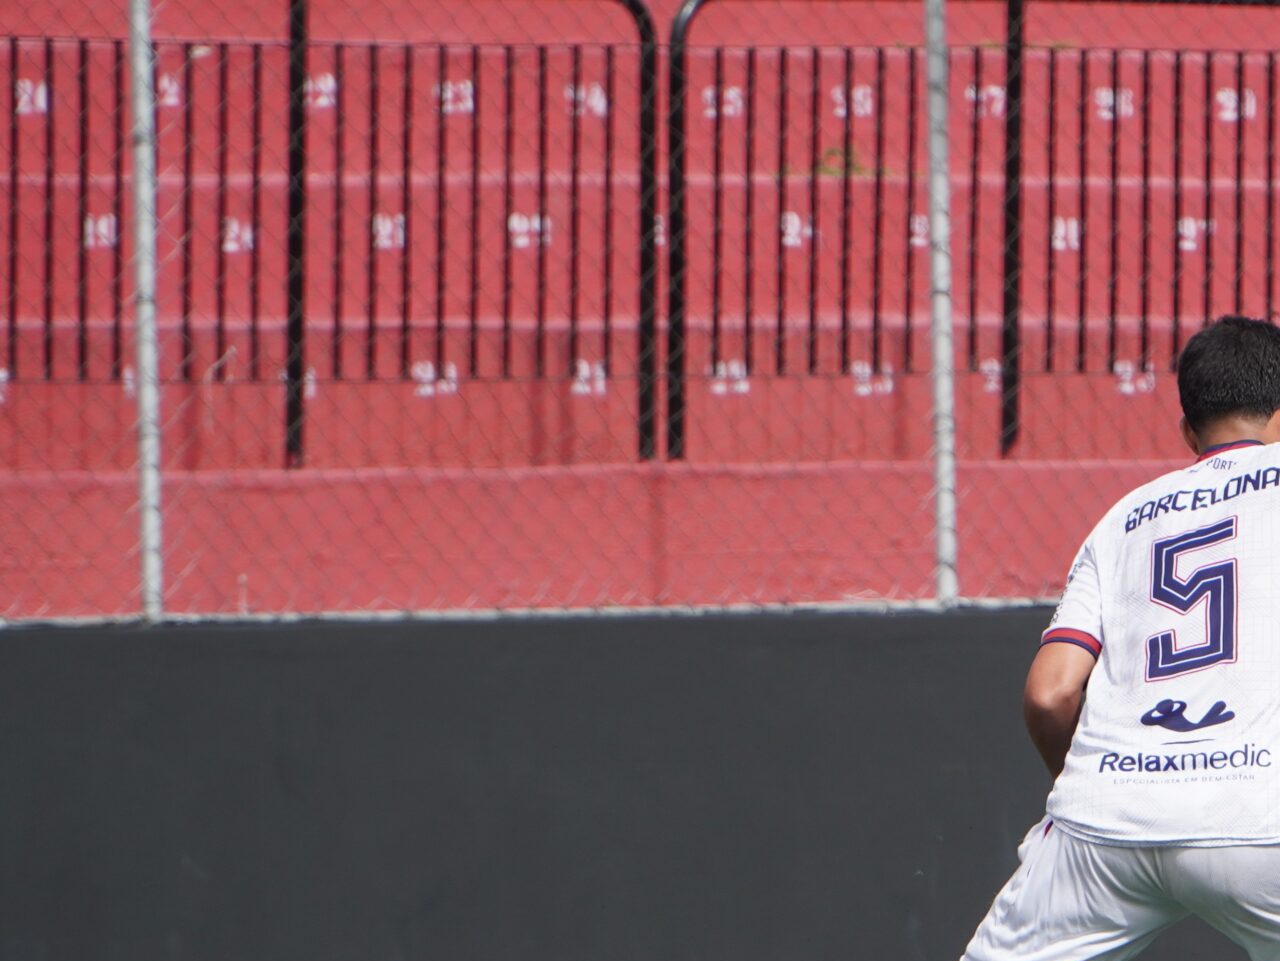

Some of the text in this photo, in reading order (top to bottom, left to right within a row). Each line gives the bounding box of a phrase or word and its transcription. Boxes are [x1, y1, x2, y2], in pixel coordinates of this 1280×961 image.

[1125, 466, 1280, 534] BARCELONA
[1145, 515, 1238, 682] 5
[1099, 743, 1272, 773] Relaxmedic
